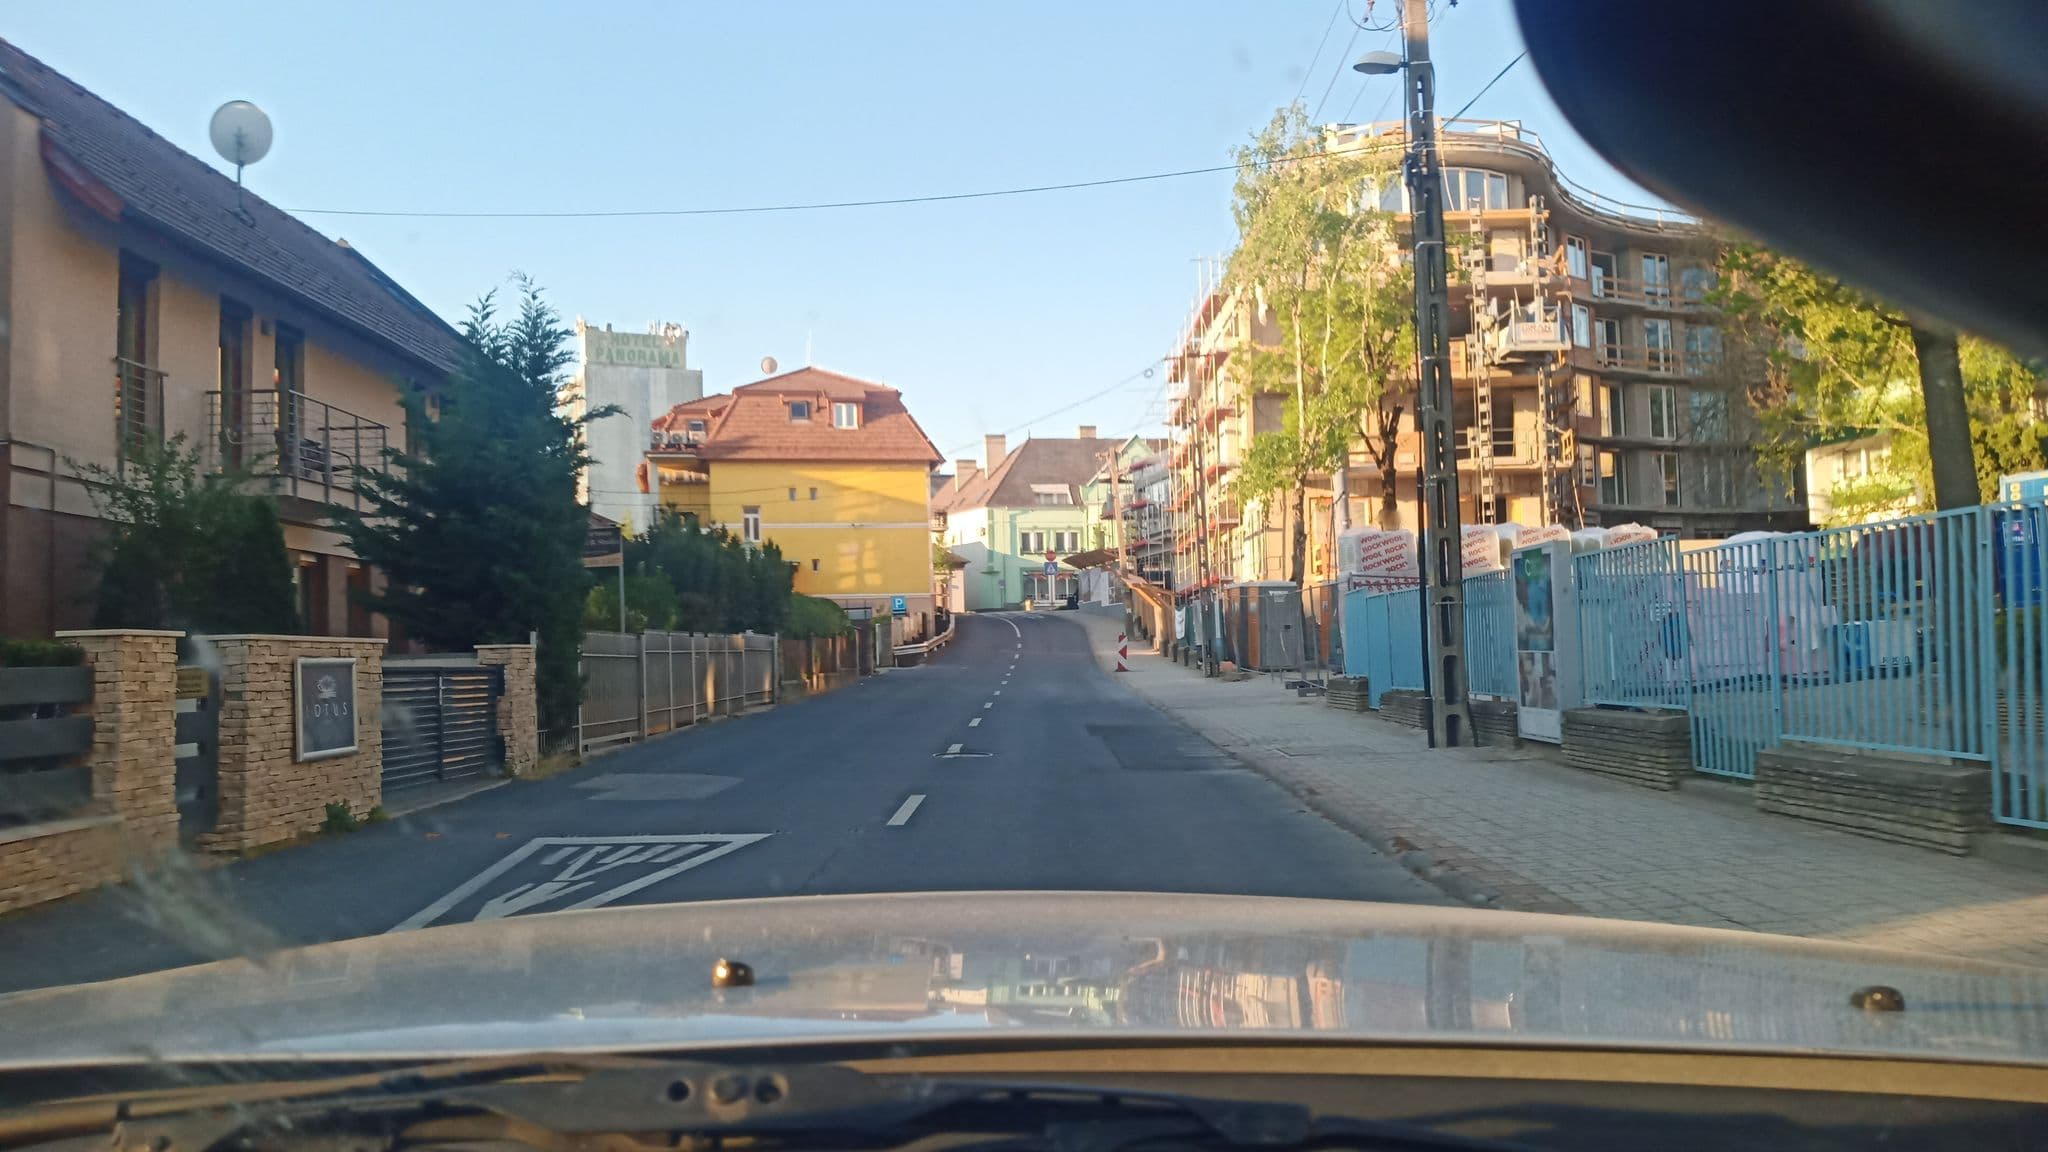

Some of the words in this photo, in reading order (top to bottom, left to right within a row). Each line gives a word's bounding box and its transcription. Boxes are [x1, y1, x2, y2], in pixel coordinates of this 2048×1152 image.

[610, 334, 659, 348] HOTEL
[596, 347, 680, 365] PANORAMA
[896, 598, 903, 608] P
